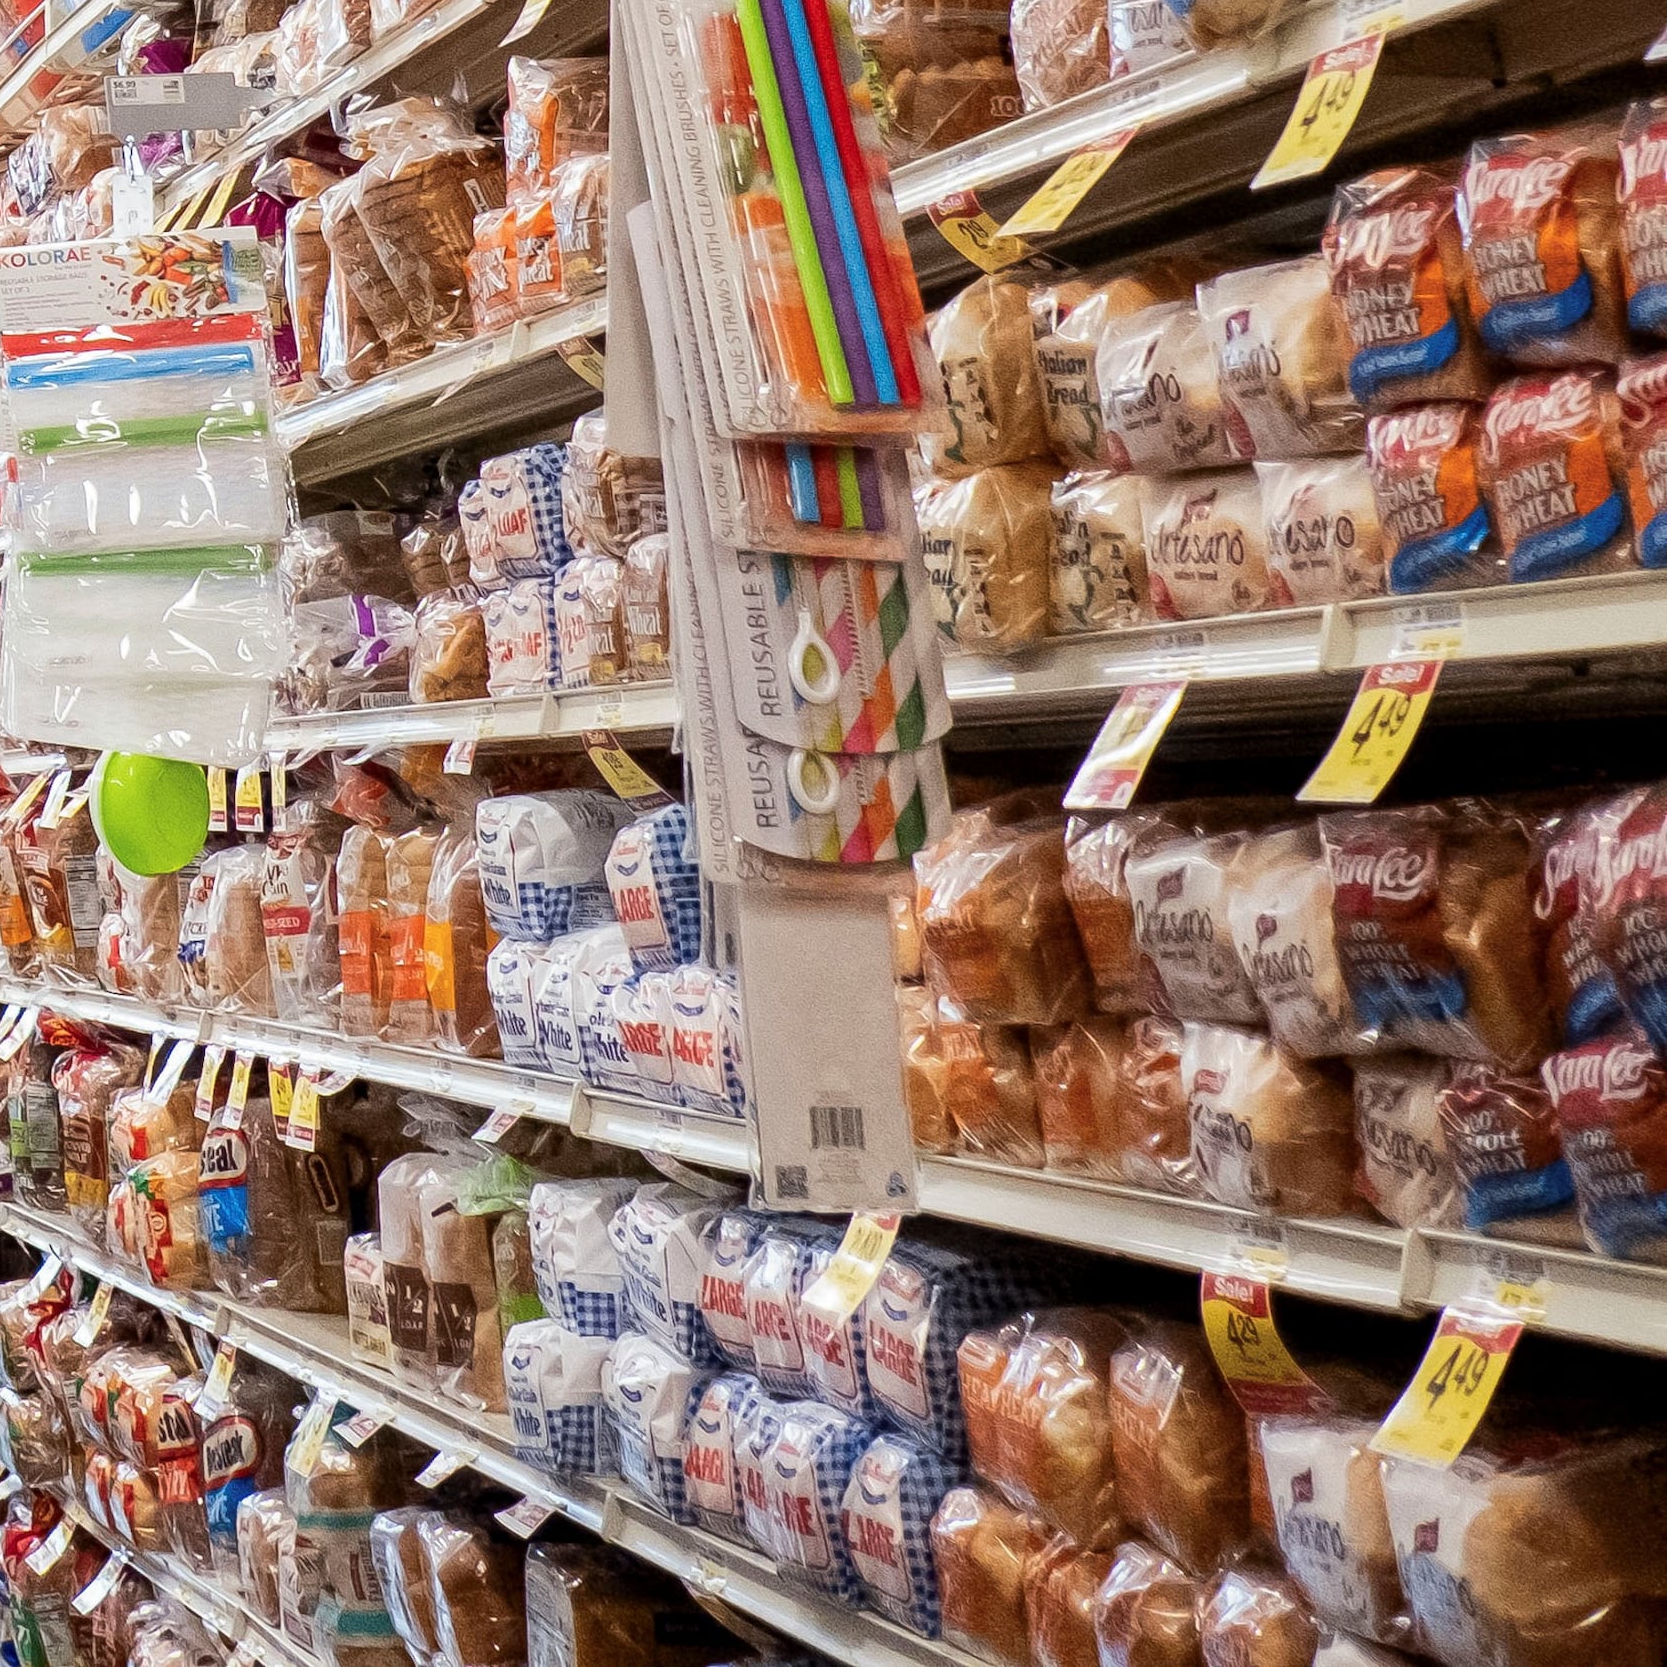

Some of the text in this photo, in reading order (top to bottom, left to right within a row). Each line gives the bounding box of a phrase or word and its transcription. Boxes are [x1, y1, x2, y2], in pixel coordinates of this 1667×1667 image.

[743, 578, 783, 718] REUSABLE
[753, 728, 782, 830] REUSA
[1214, 1277, 1257, 1303] Sale!
